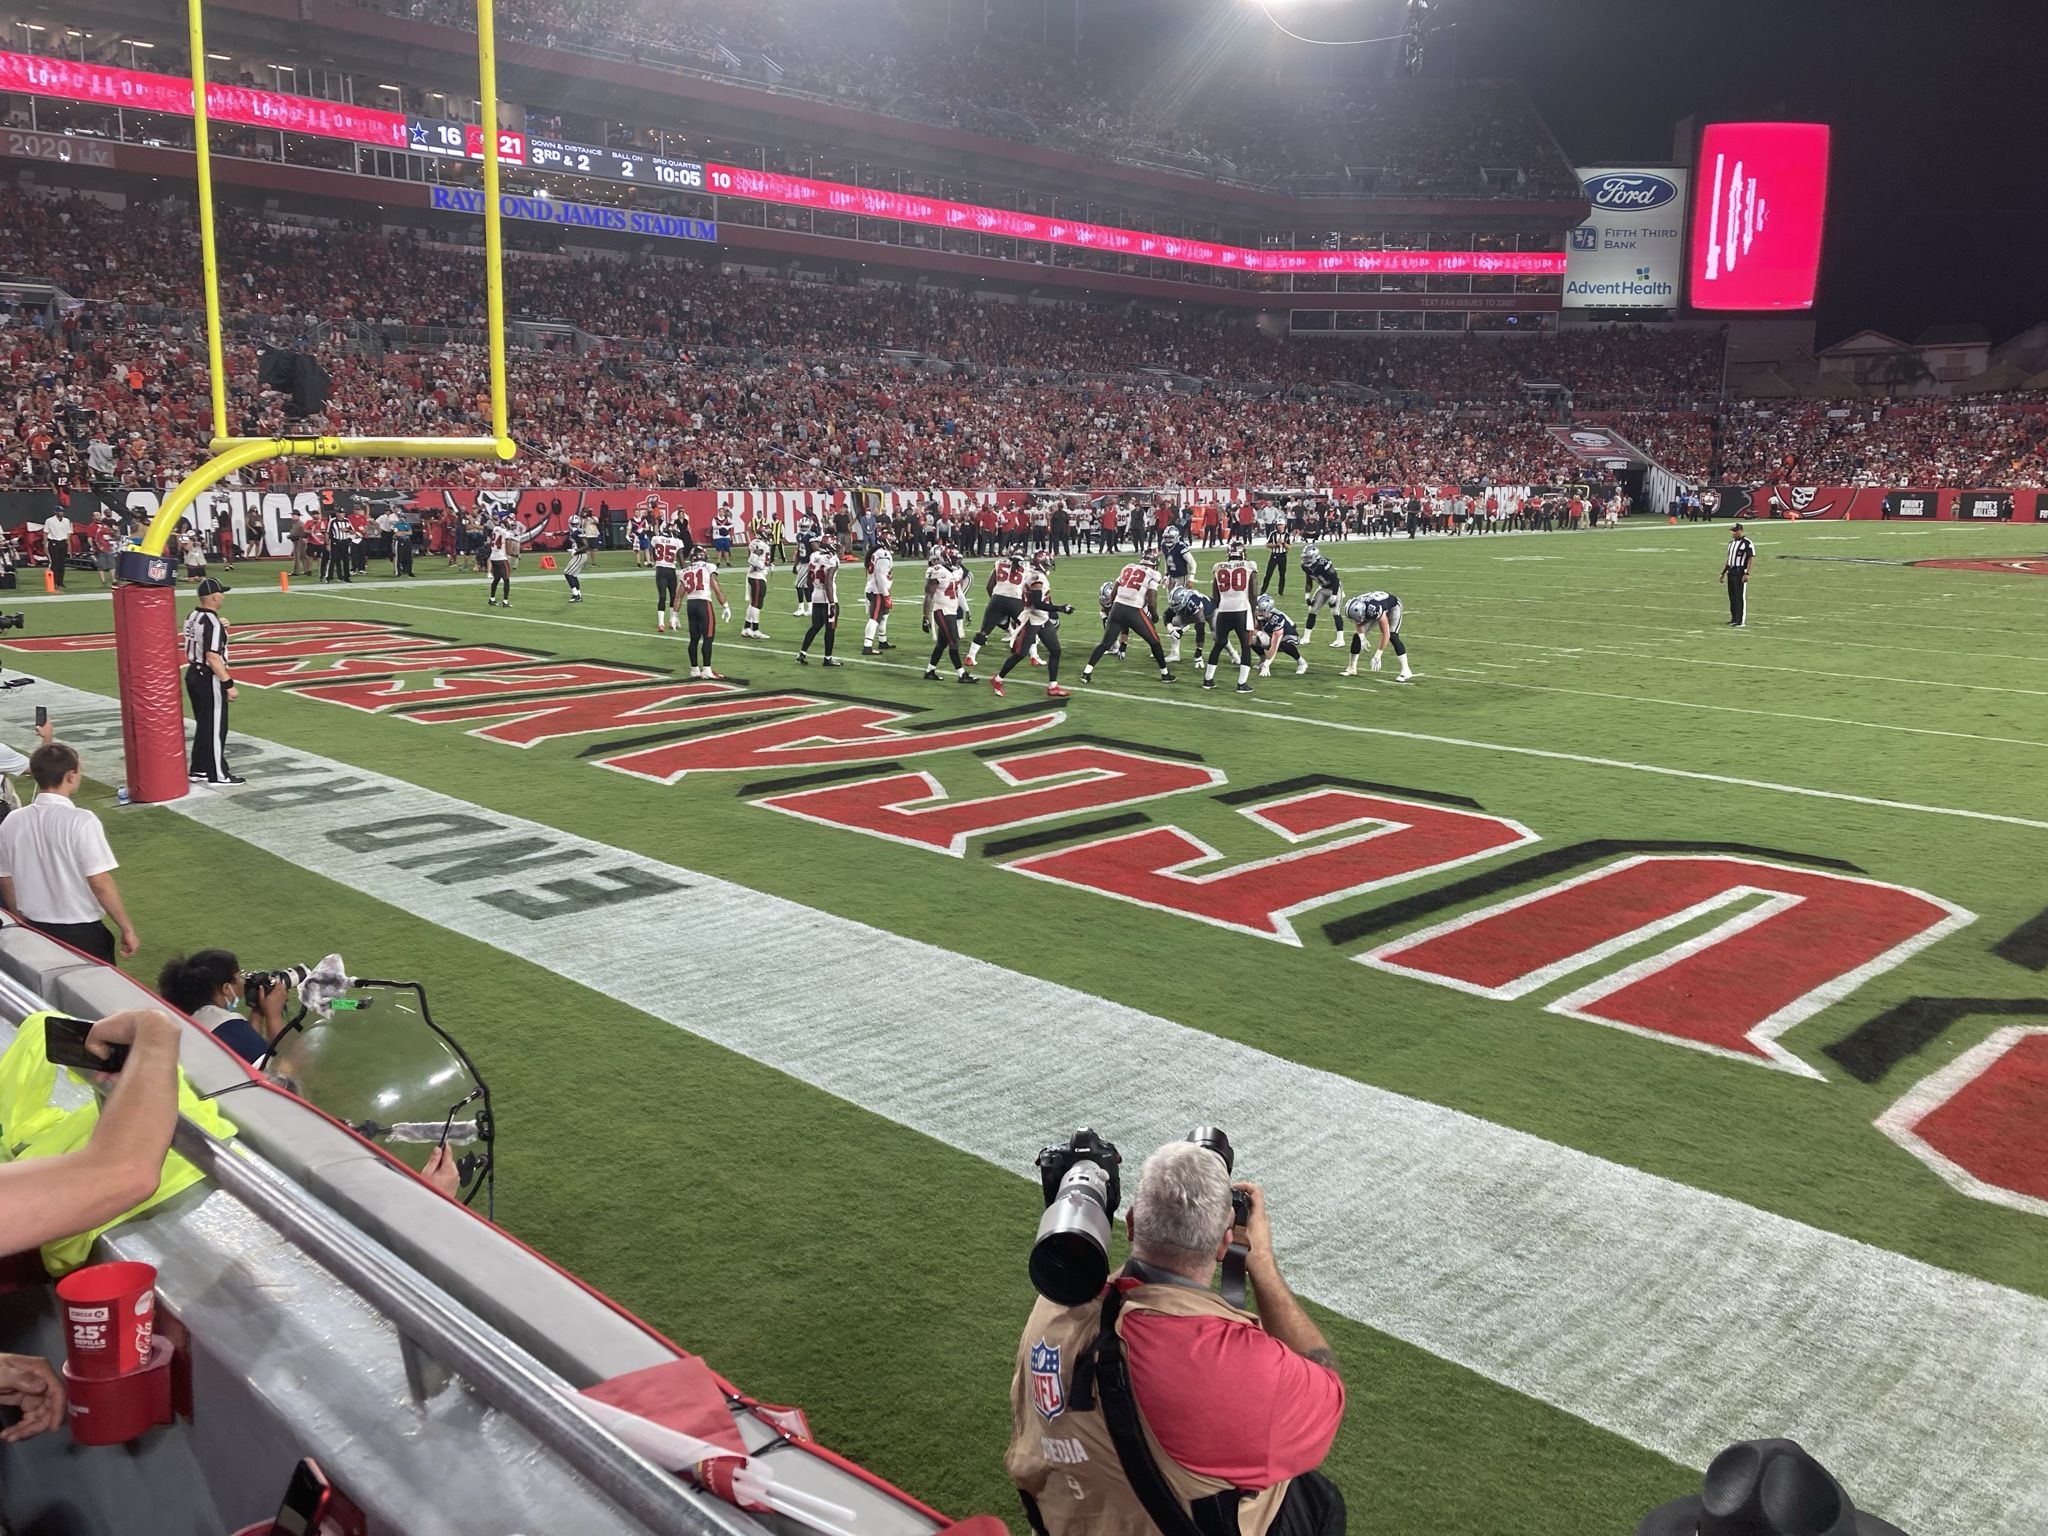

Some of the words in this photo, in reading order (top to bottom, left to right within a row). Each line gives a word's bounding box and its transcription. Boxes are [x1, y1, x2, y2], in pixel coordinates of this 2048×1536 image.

[438, 125, 461, 145] 16
[500, 135, 521, 154] 21
[8, 134, 72, 160] 2020
[531, 139, 556, 149] DOWN
[564, 144, 602, 156] DISTANCE
[612, 151, 630, 160] BALL
[632, 154, 643, 162] ON
[532, 147, 560, 165] 3RD
[563, 155, 573, 167] &
[577, 154, 590, 171] 2
[621, 161, 634, 177] 2
[652, 157, 667, 165] 3RD
[668, 160, 701, 170] QUARTER
[654, 165, 701, 186] 10:05
[711, 172, 730, 188] 10
[1596, 178, 1657, 204] Ford
[433, 187, 553, 220] RAYOND
[556, 203, 626, 230] JAMES
[631, 213, 716, 241] STADIUM
[1605, 228, 1637, 238] FIFTH
[1642, 228, 1677, 238] THIRD
[1604, 240, 1637, 249] BANK
[1567, 281, 1672, 295] AdventHealth
[1421, 298, 1438, 306] TEXT
[1440, 298, 1455, 307] FAN
[1457, 298, 1481, 307] ISSUES
[1485, 298, 1494, 307] TO
[57, 477, 67, 486] 12
[322, 491, 334, 505] 3
[655, 543, 677, 563] 35
[149, 567, 165, 578] NFL
[683, 568, 705, 595] 31
[997, 562, 1025, 586] 56
[1119, 567, 1147, 592] 92
[1217, 567, 1247, 593] 90
[325, 811, 692, 922] END
[1032, 1374, 1061, 1412] NFL
[1041, 1436, 1090, 1464] MEDIA
